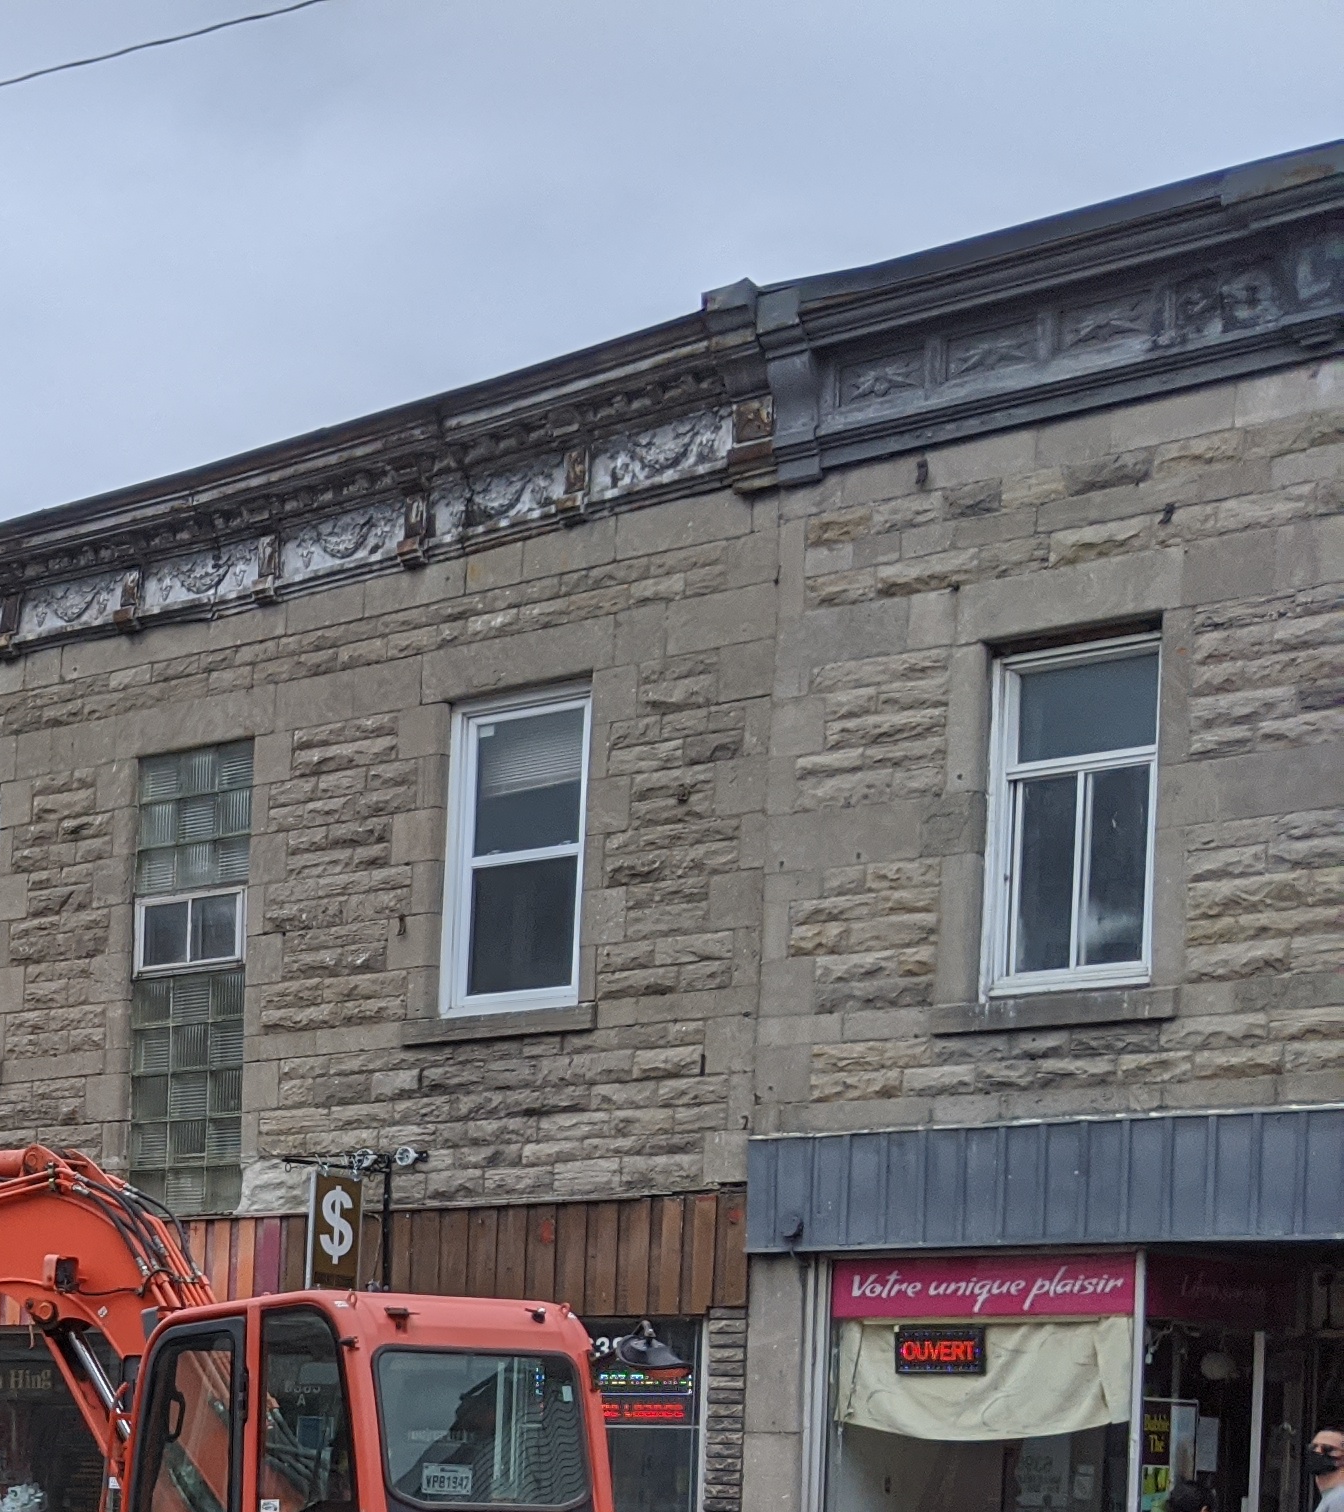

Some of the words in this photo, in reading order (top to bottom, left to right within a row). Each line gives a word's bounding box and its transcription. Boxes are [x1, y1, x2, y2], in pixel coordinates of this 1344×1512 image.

[319, 1185, 353, 1264] $
[852, 1270, 922, 1298] Votre
[928, 1276, 1027, 1312] unique
[1023, 1266, 1123, 1311] plaisir
[901, 1341, 975, 1361] OUVERT
[9, 1369, 51, 1390] Hing
